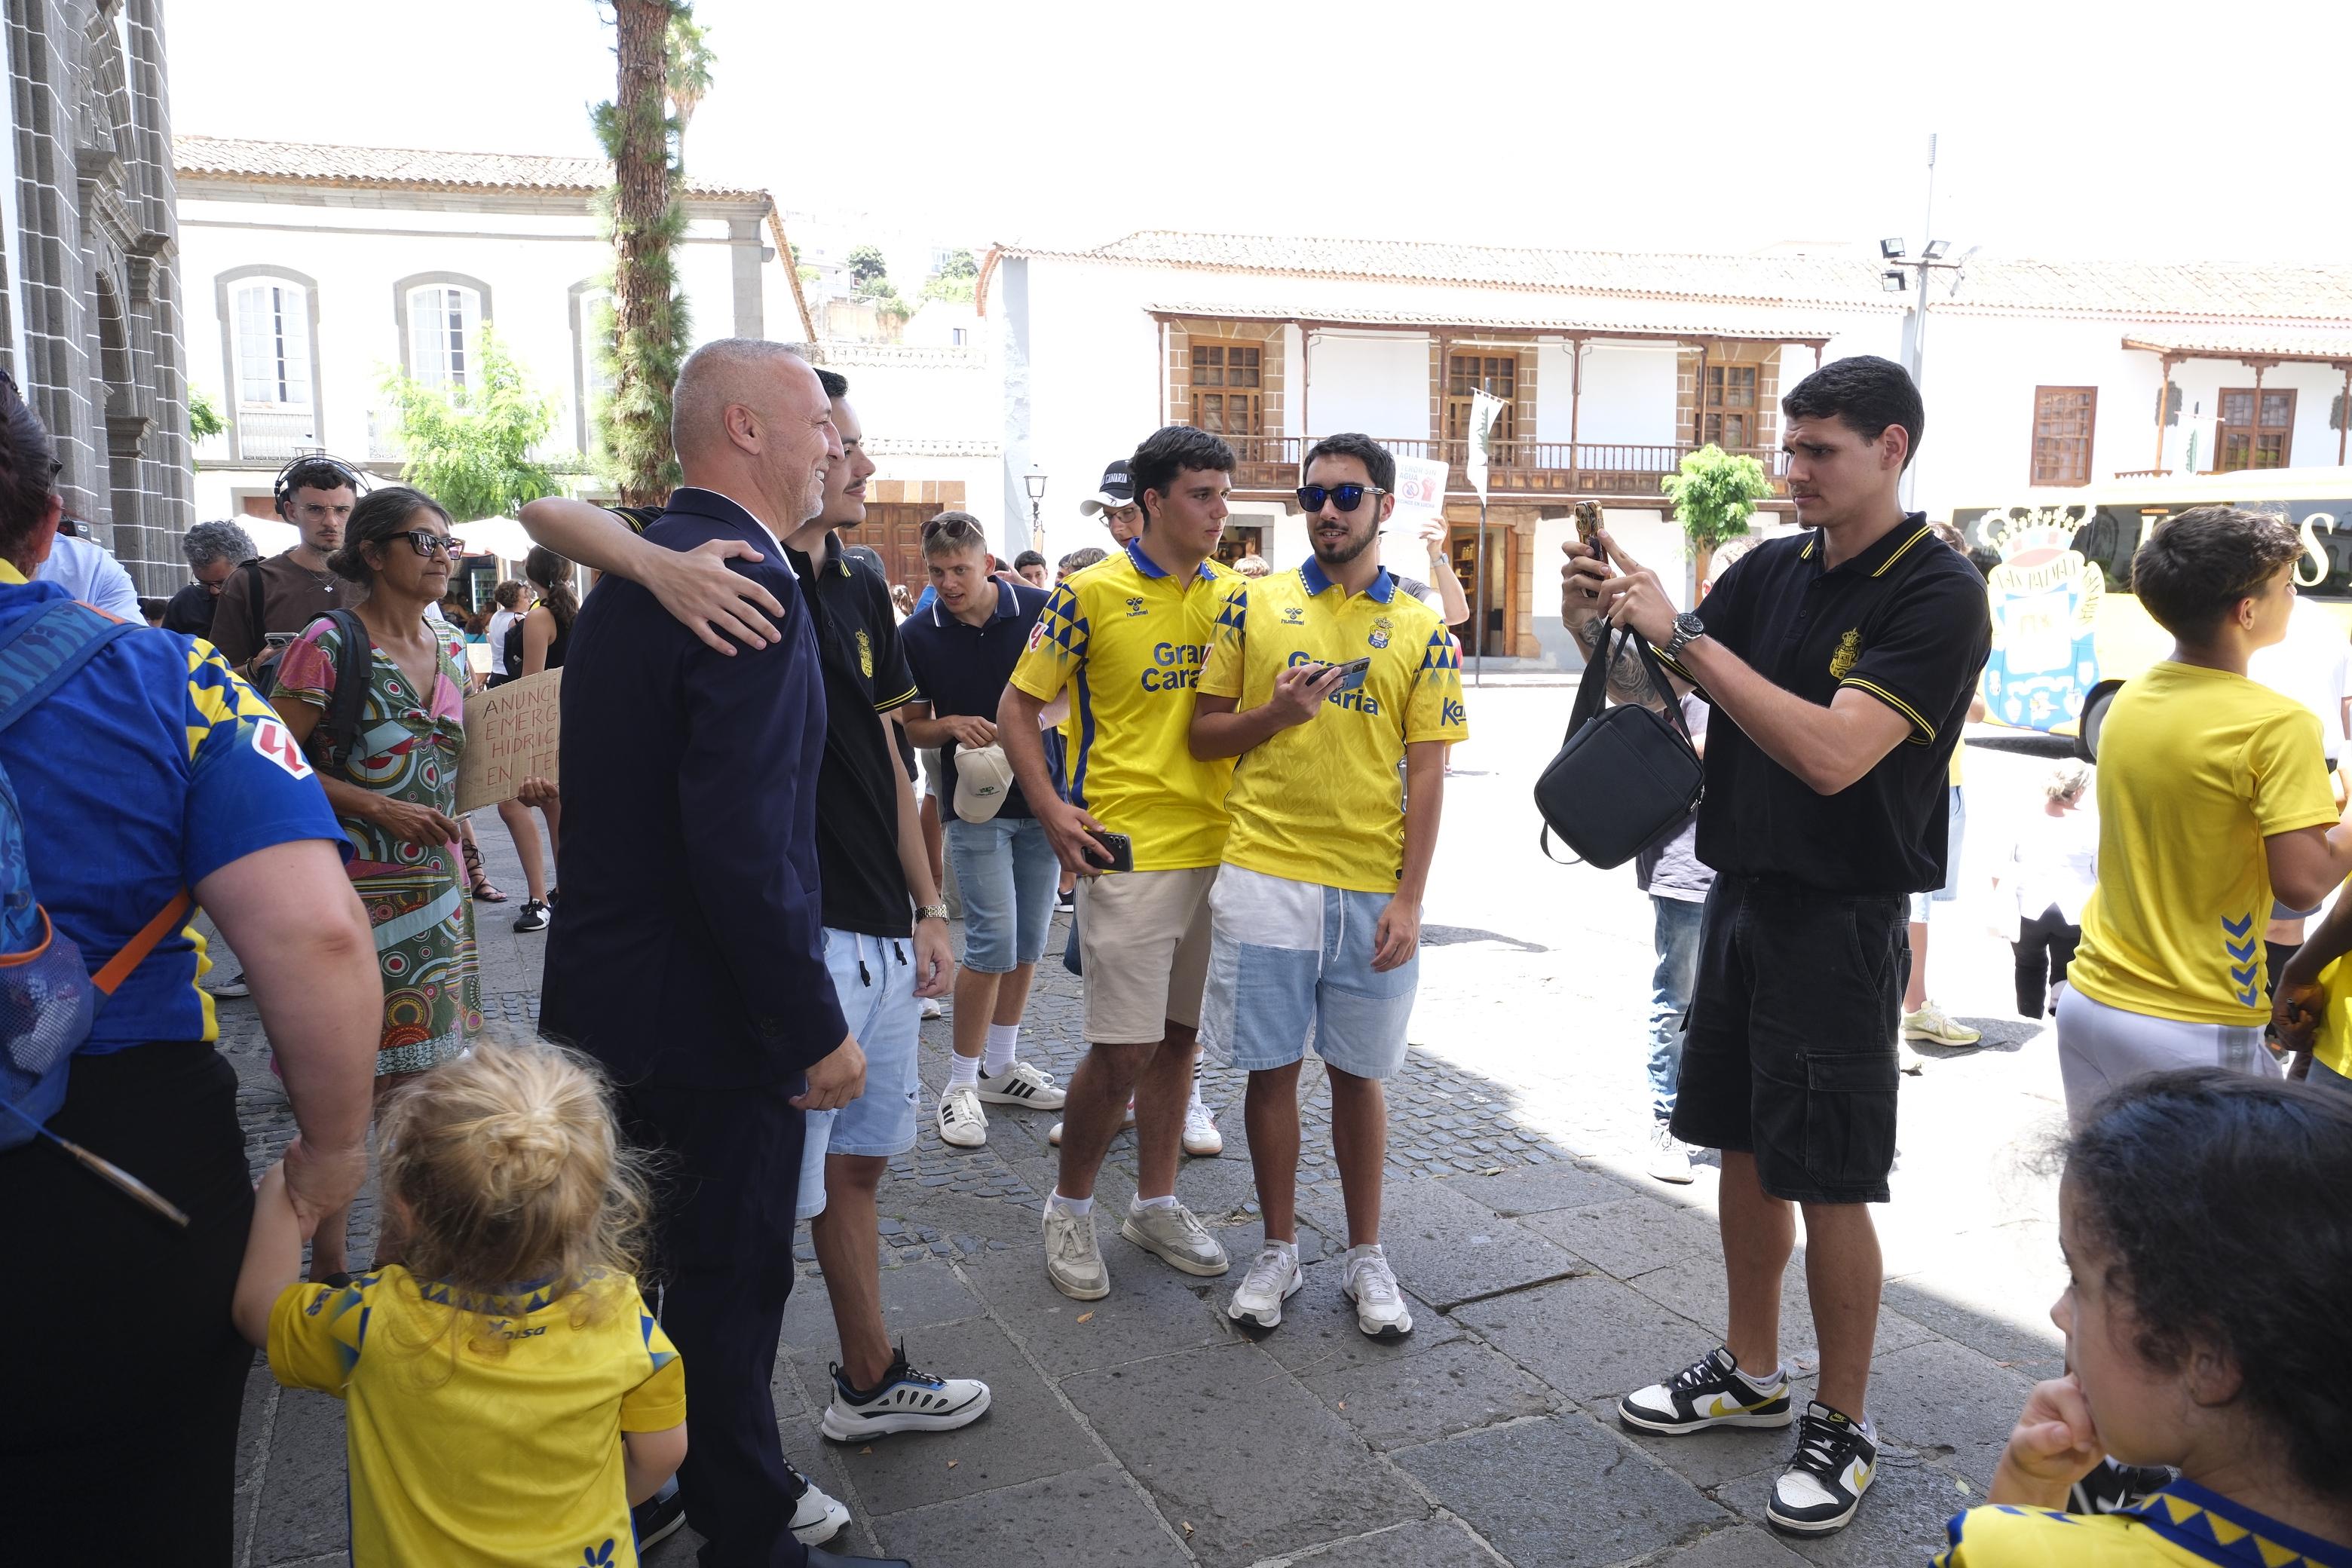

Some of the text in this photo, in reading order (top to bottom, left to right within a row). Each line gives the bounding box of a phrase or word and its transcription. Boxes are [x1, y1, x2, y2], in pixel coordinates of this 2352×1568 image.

[1104, 473, 1128, 484] CANARIA
[1398, 472, 1418, 481] AGUA
[1126, 609, 1149, 617] hummel
[1441, 697, 1467, 726] Ka
[492, 727, 559, 758] HIDRIC
[487, 762, 513, 786] EN
